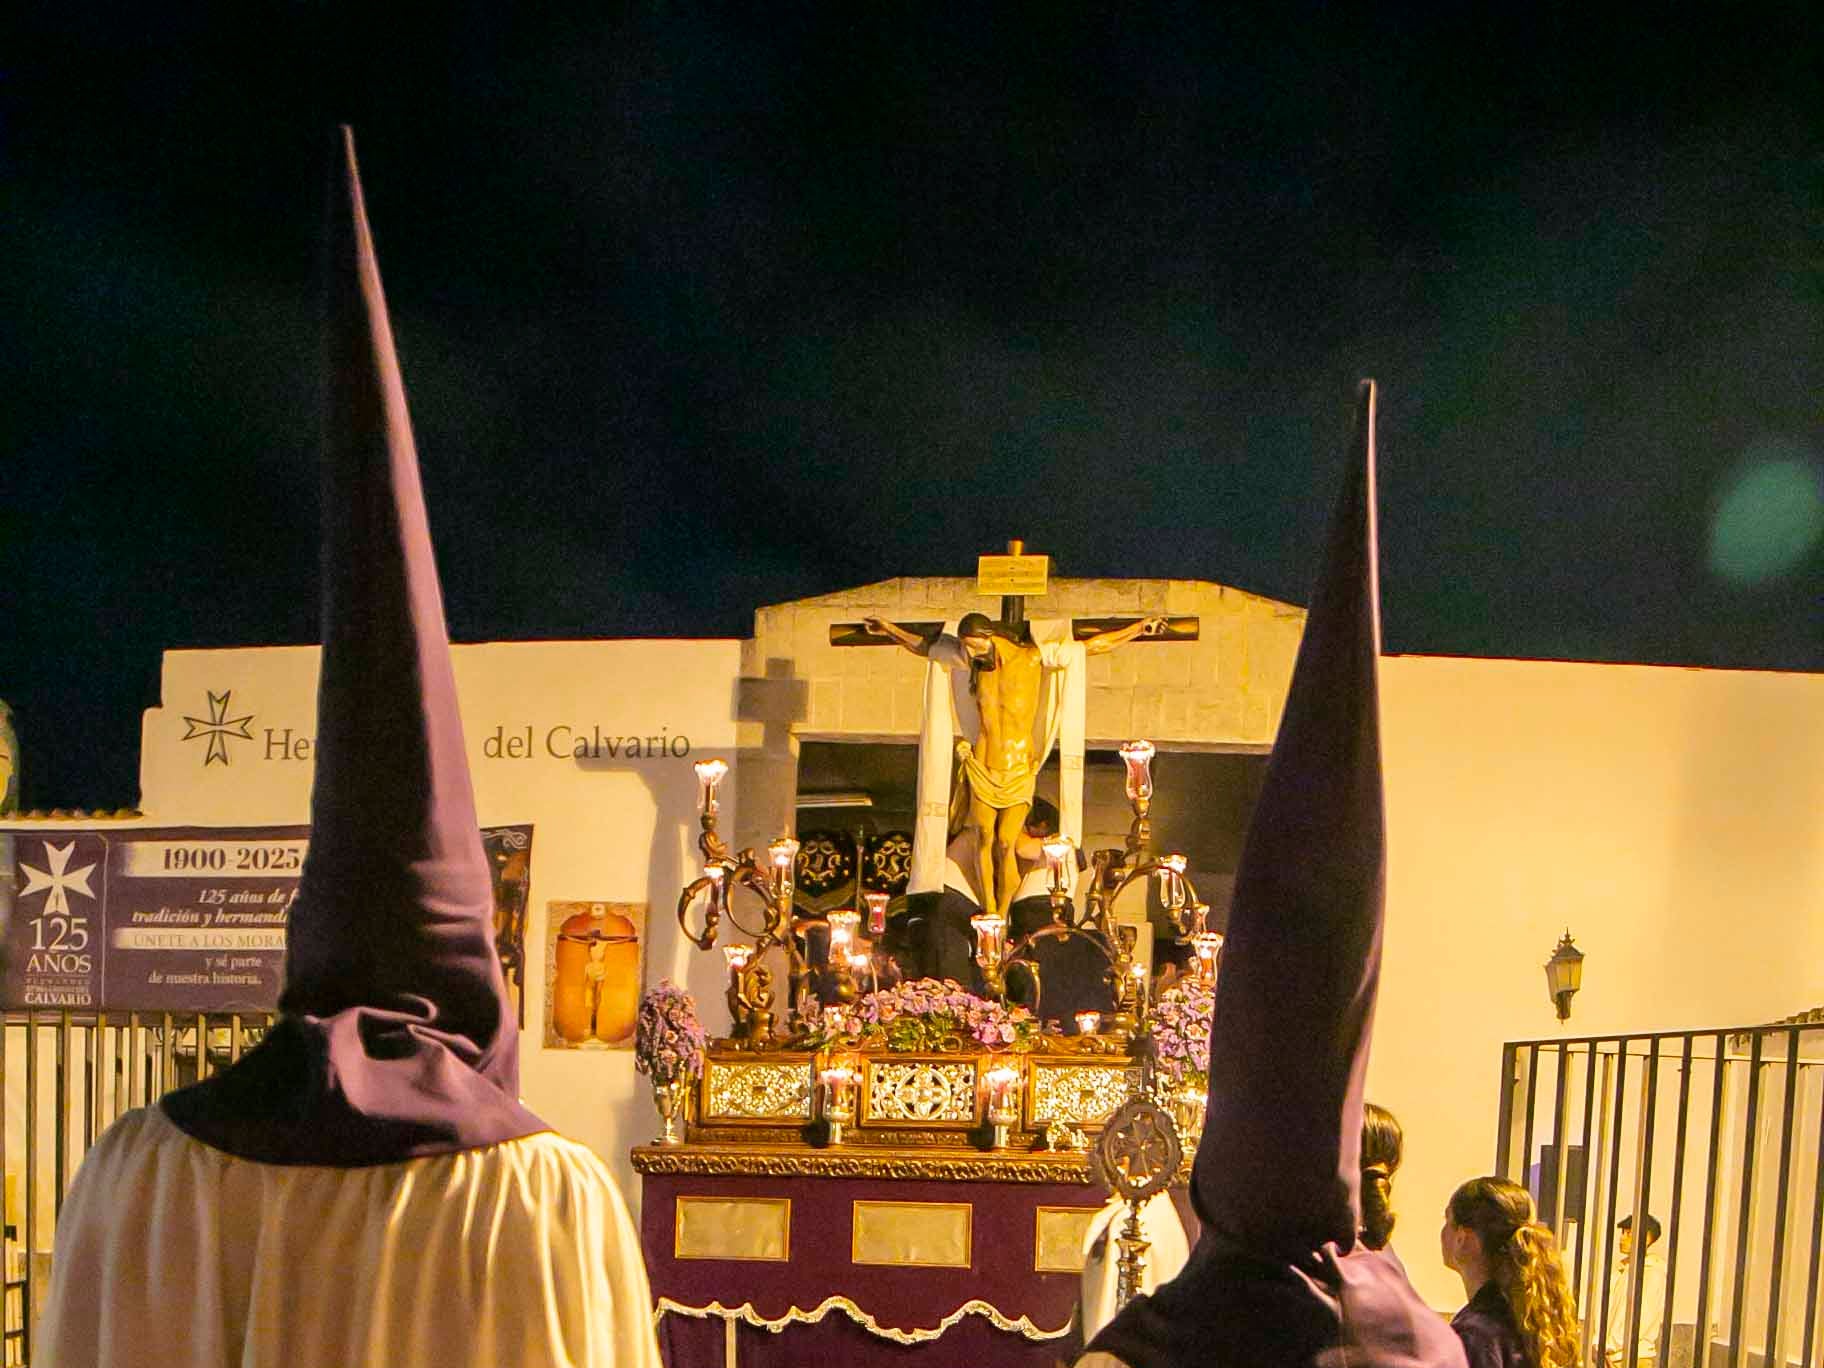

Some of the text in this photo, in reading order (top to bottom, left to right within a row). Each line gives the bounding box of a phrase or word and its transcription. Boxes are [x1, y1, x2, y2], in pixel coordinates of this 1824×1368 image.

[483, 726, 533, 759] del
[546, 726, 691, 760] Calvario
[199, 889, 228, 904] 125
[229, 889, 264, 904] años
[267, 888, 287, 904] de
[131, 907, 288, 927] tradición y hermand
[29, 917, 89, 951] 125
[203, 934, 234, 948] LOS
[237, 934, 286, 948] MORA
[25, 949, 92, 973] AÑOS
[148, 971, 163, 984] de
[166, 972, 210, 984] nuestra
[24, 992, 92, 1005] CALVARIO
